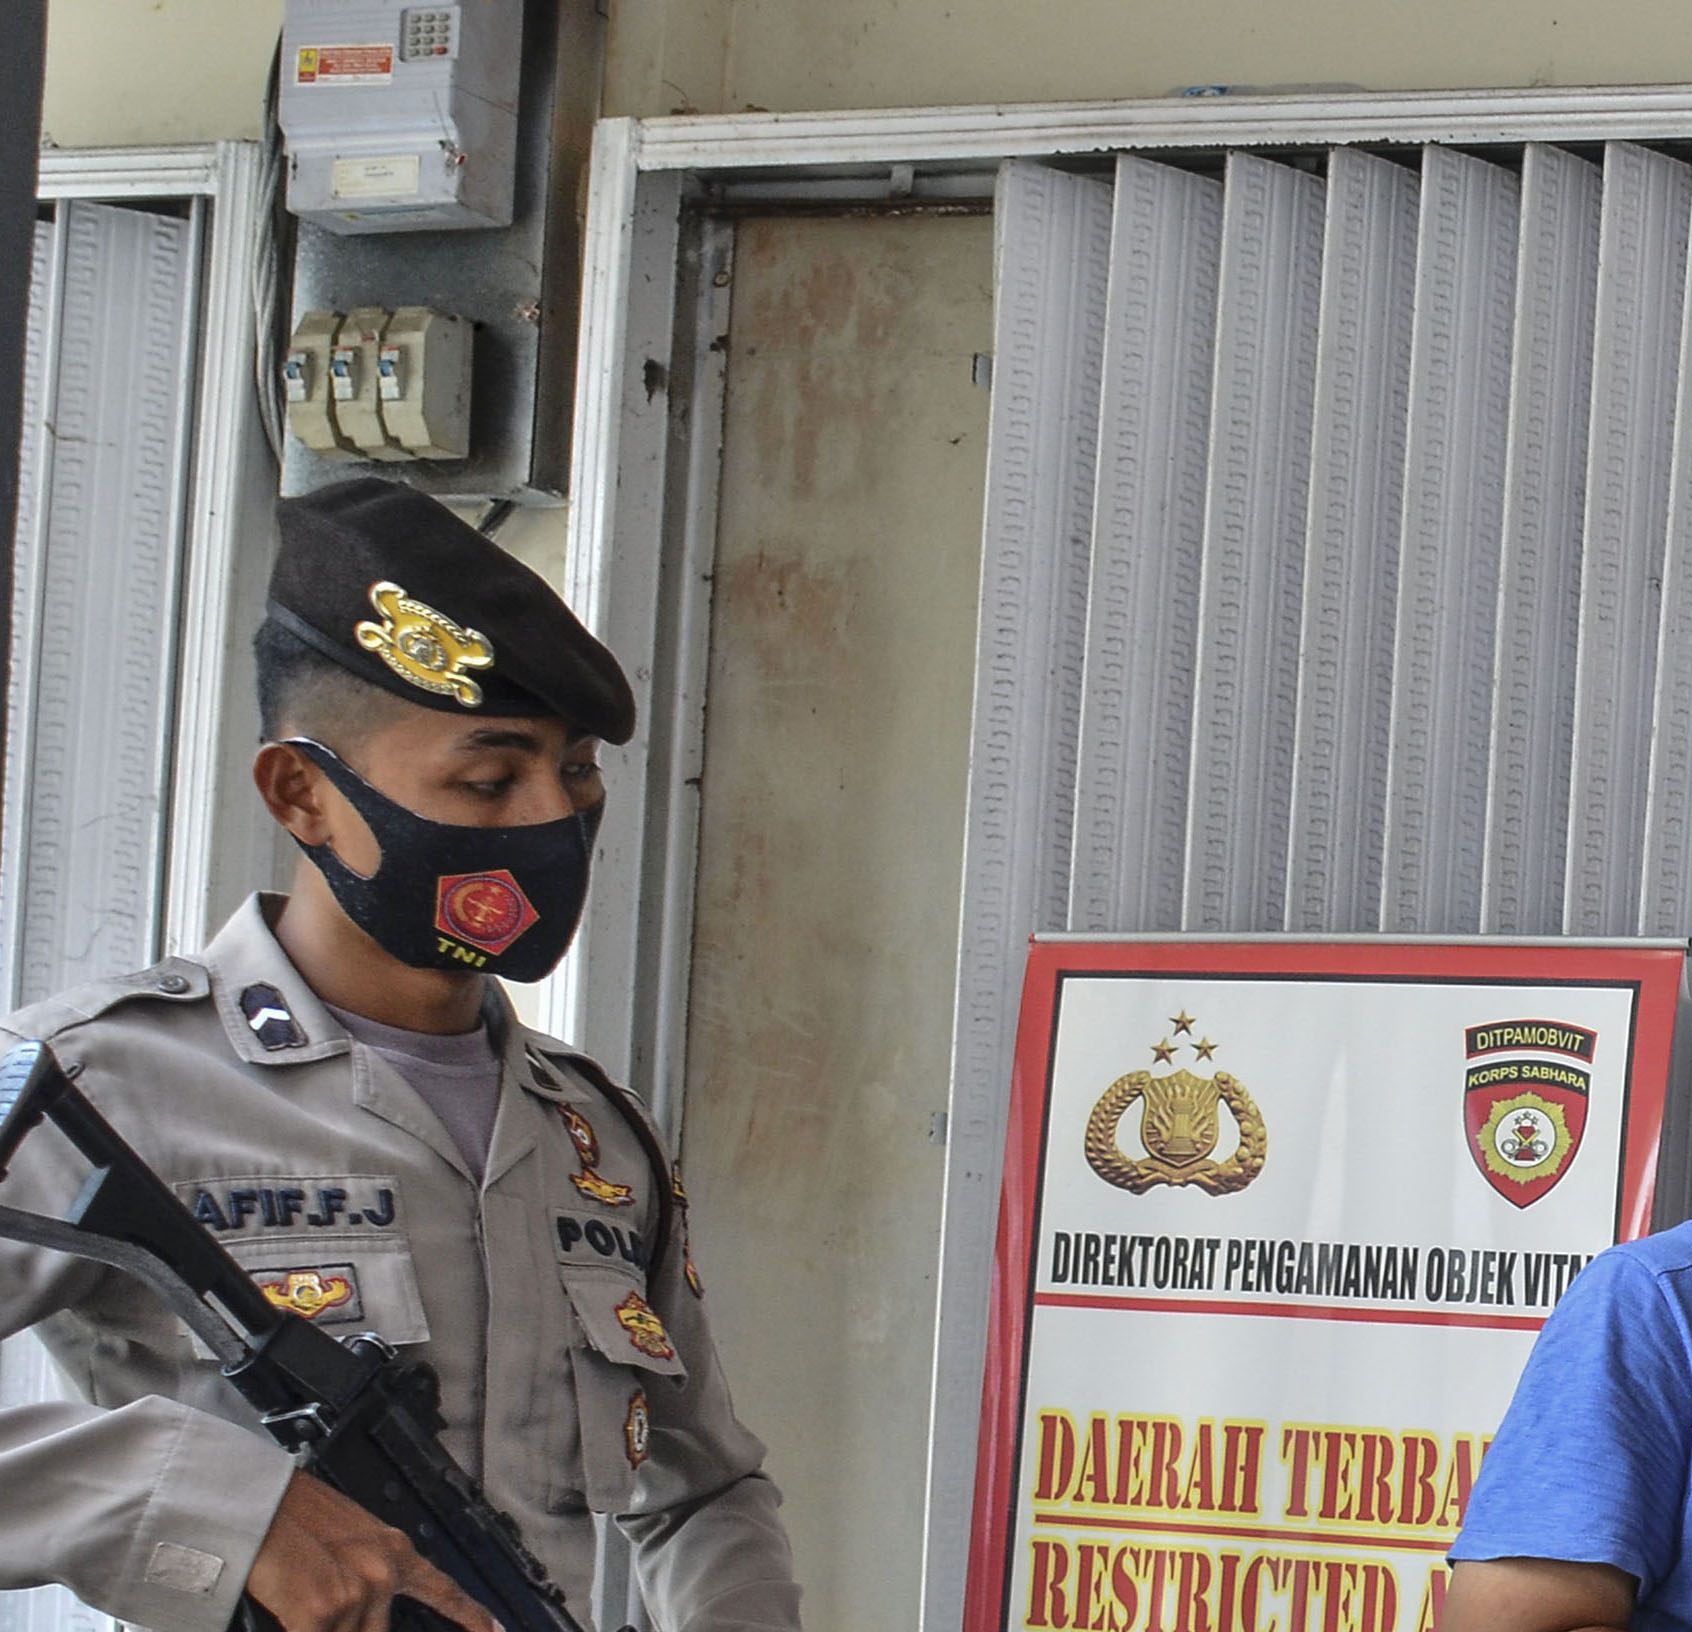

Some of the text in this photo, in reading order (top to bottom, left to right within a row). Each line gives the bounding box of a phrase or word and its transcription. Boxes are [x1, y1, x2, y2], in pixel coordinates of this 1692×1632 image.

[437, 936, 487, 967] TNI
[1476, 1027, 1585, 1051] DITPAMOBVIT
[1468, 1065, 1587, 1091] KORPS SABHARA
[1050, 1231, 1594, 1307] DIREKTORAT PENGAMANAN OBJEK VITA
[1033, 1412, 1493, 1528] DAERAH TERBA
